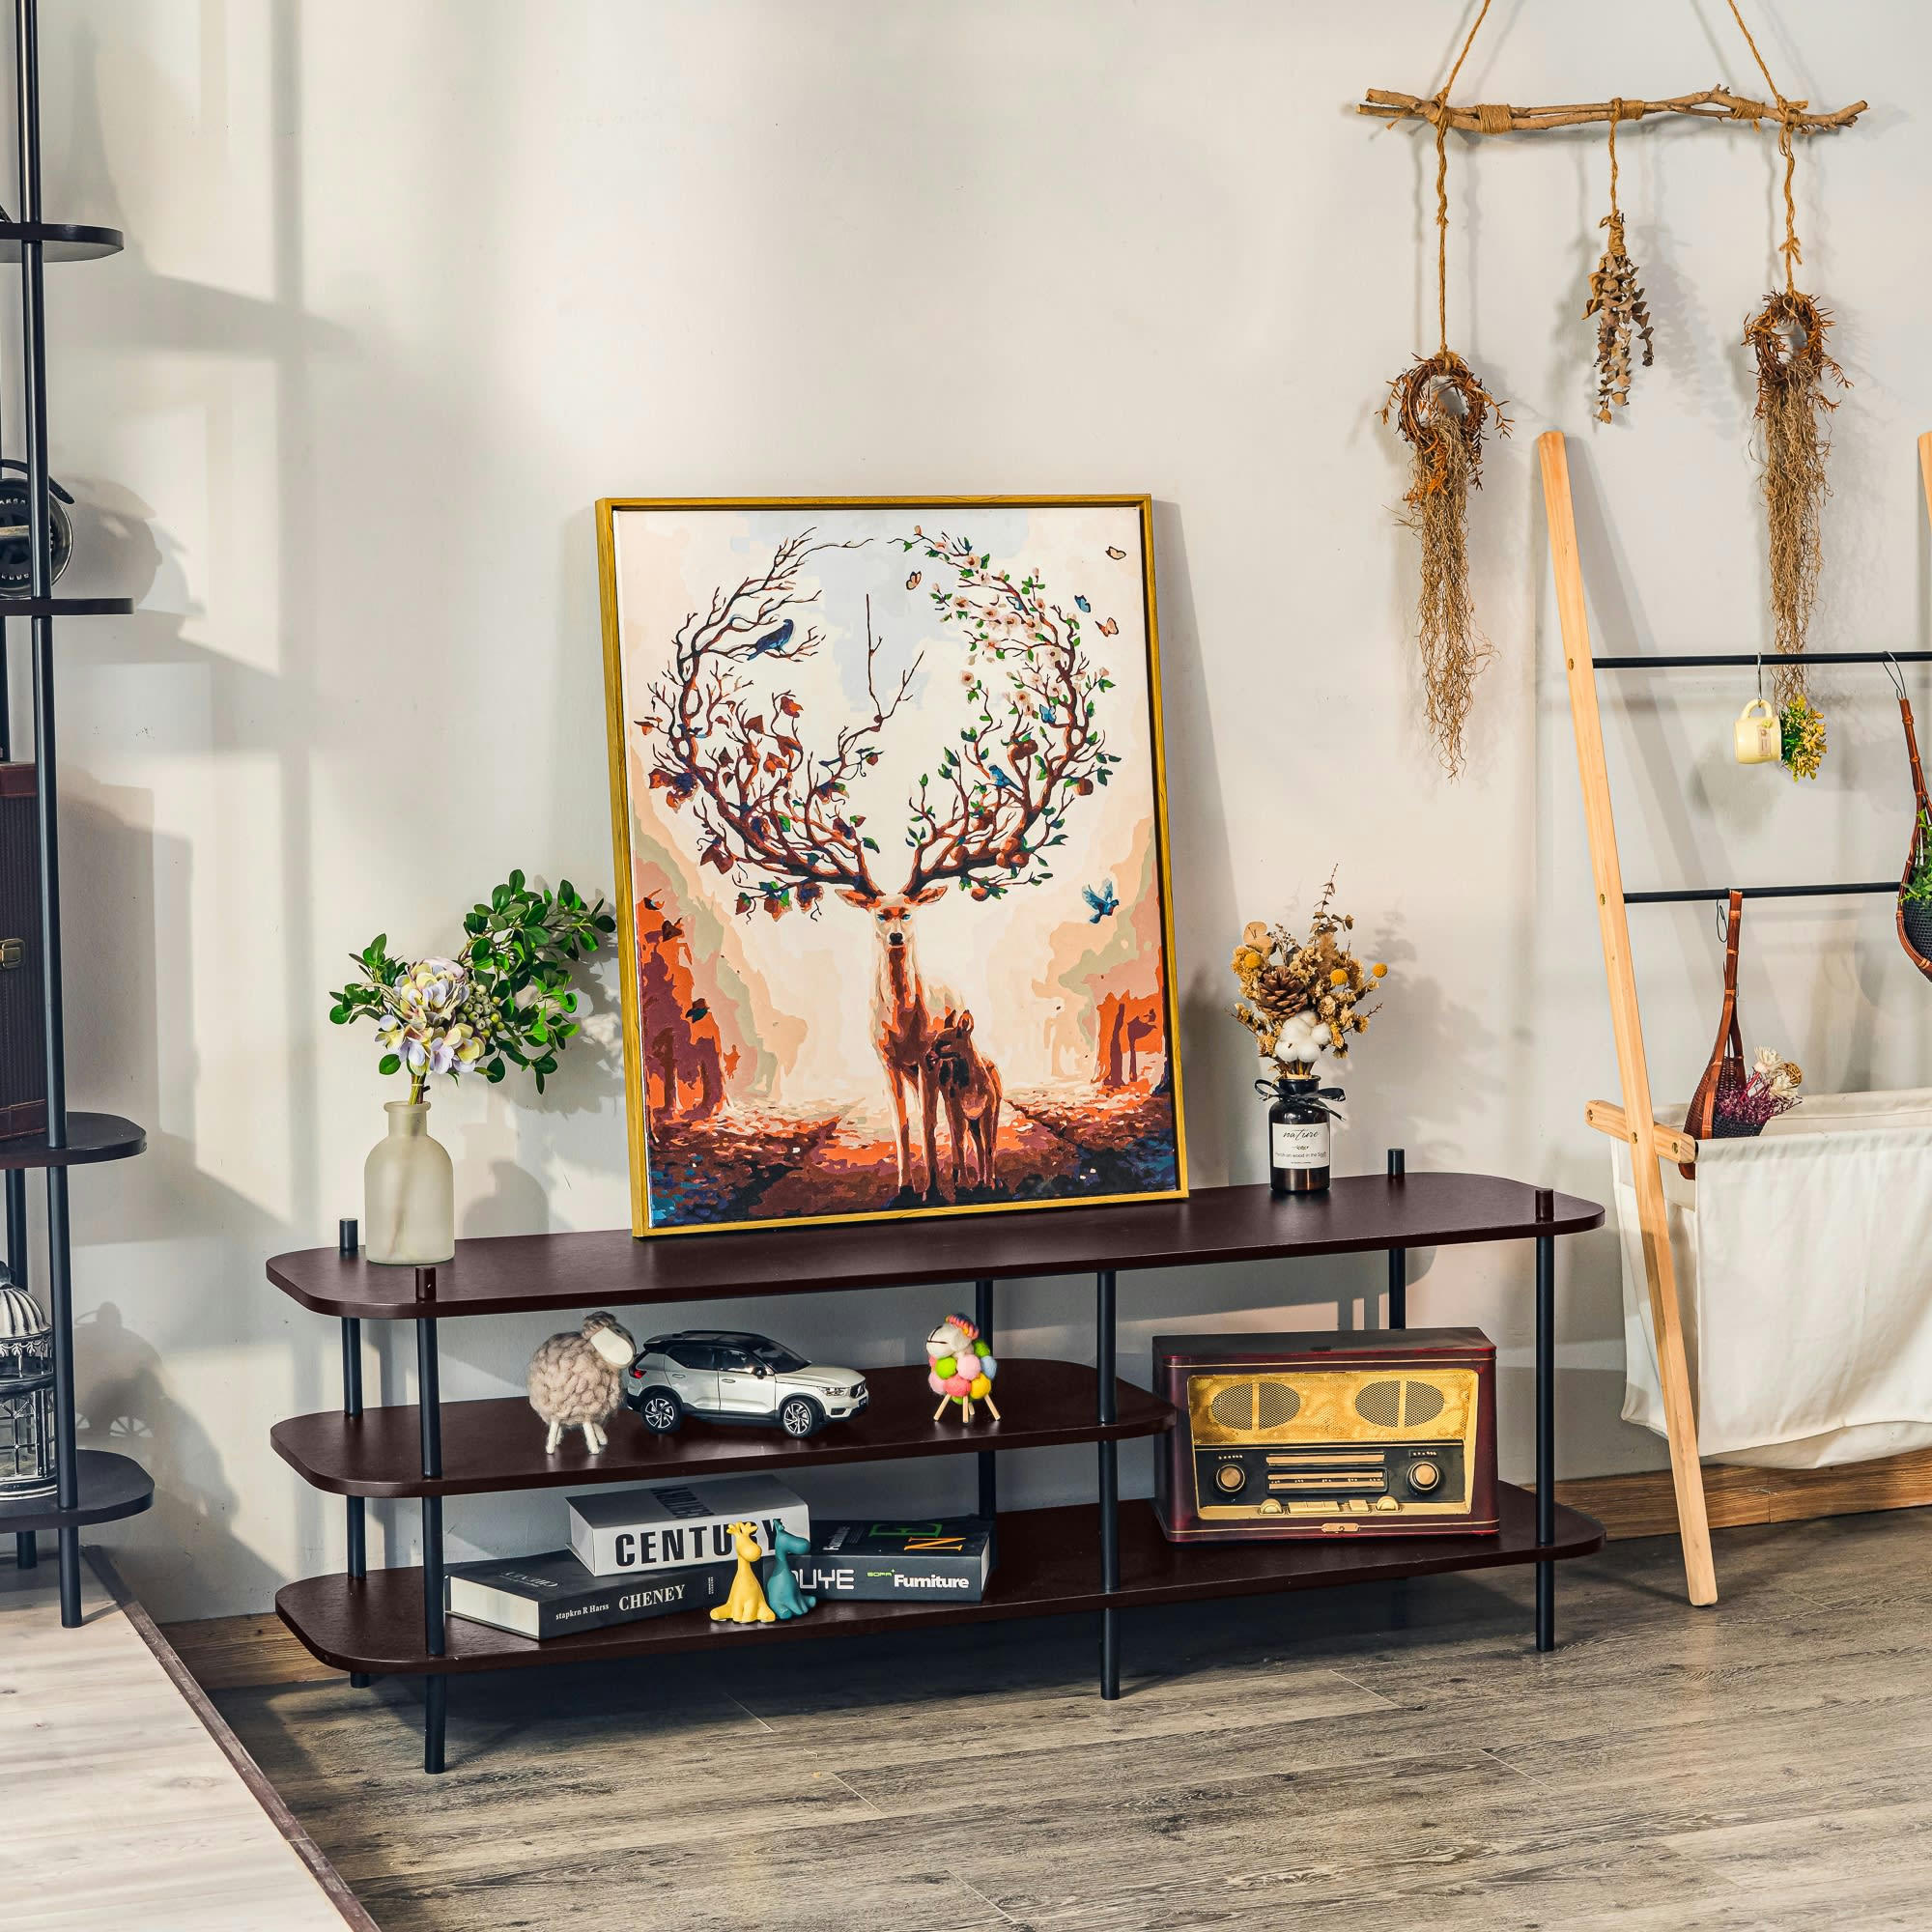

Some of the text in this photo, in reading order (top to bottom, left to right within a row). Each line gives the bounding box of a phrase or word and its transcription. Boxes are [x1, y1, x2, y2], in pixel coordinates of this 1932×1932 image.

[790, 1568, 855, 1590] UYE
[894, 1574, 970, 1589] Furniture
[618, 1584, 686, 1611] CHENEY
